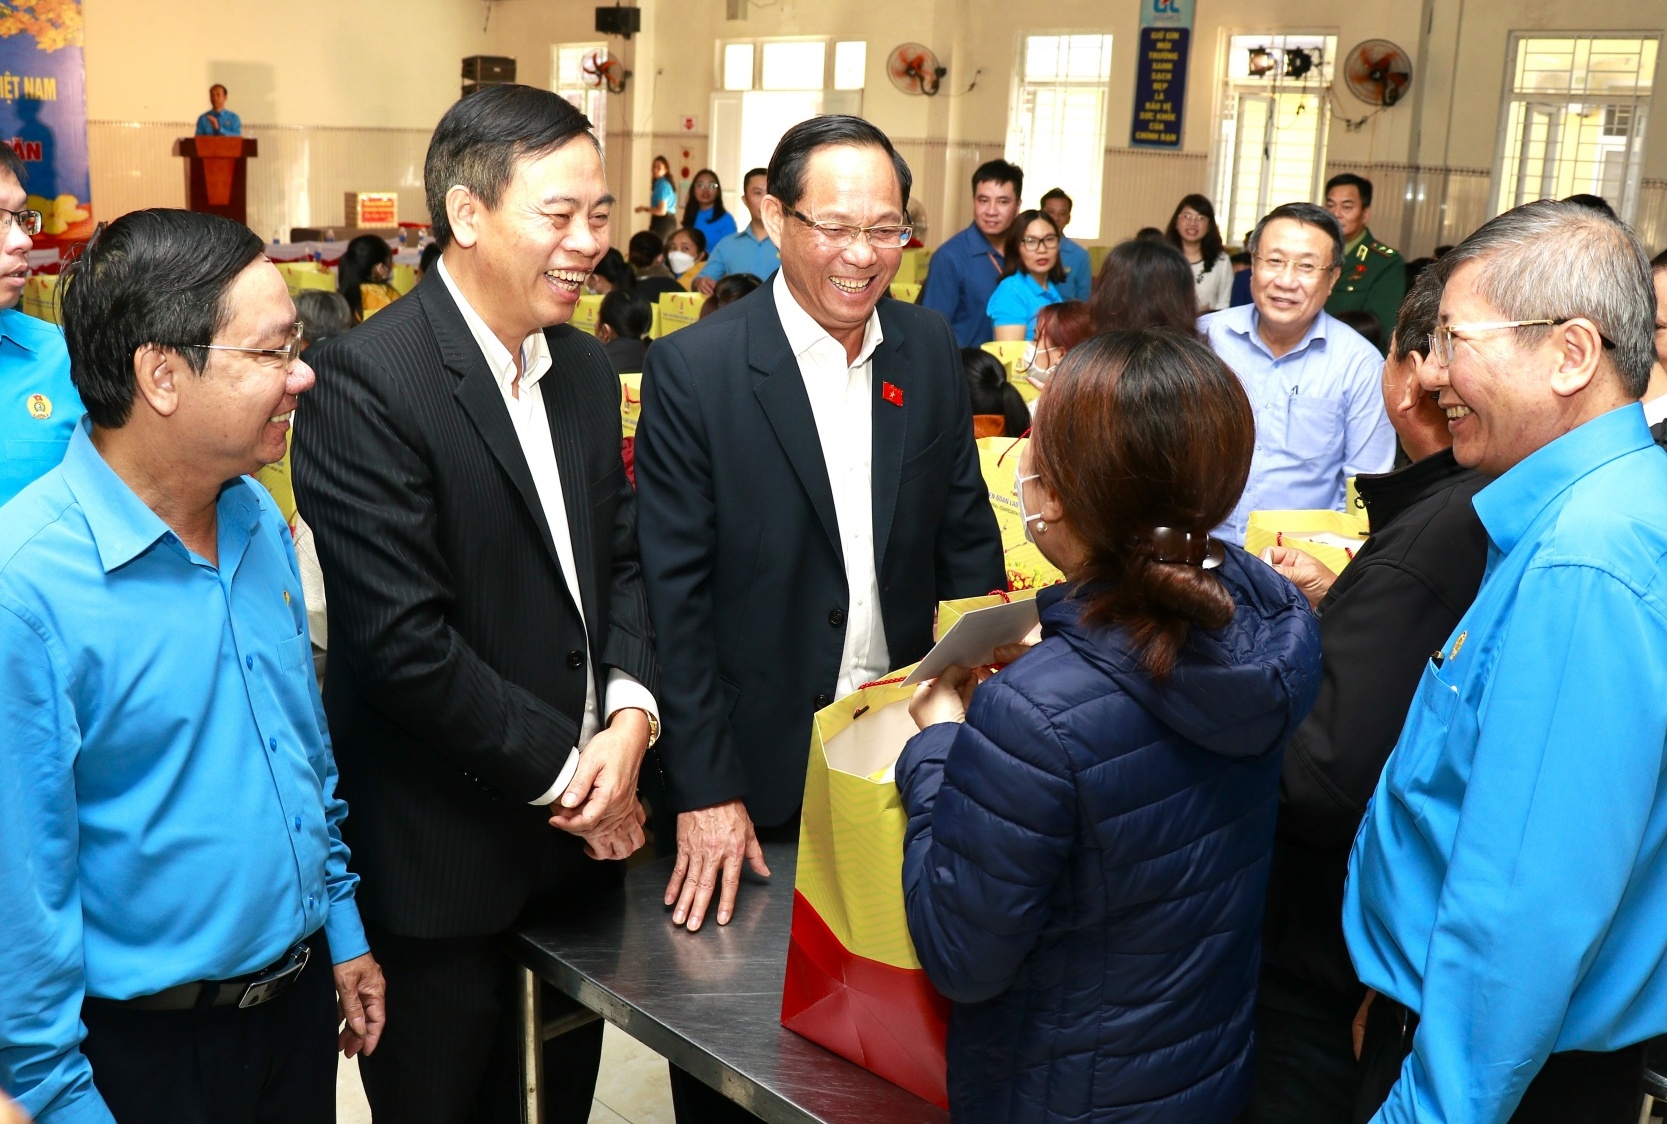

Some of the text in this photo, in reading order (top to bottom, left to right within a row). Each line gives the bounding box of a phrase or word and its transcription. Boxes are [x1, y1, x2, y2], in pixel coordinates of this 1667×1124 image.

[0, 70, 57, 105] IỆT NAM
[4, 137, 42, 161] ĂN
